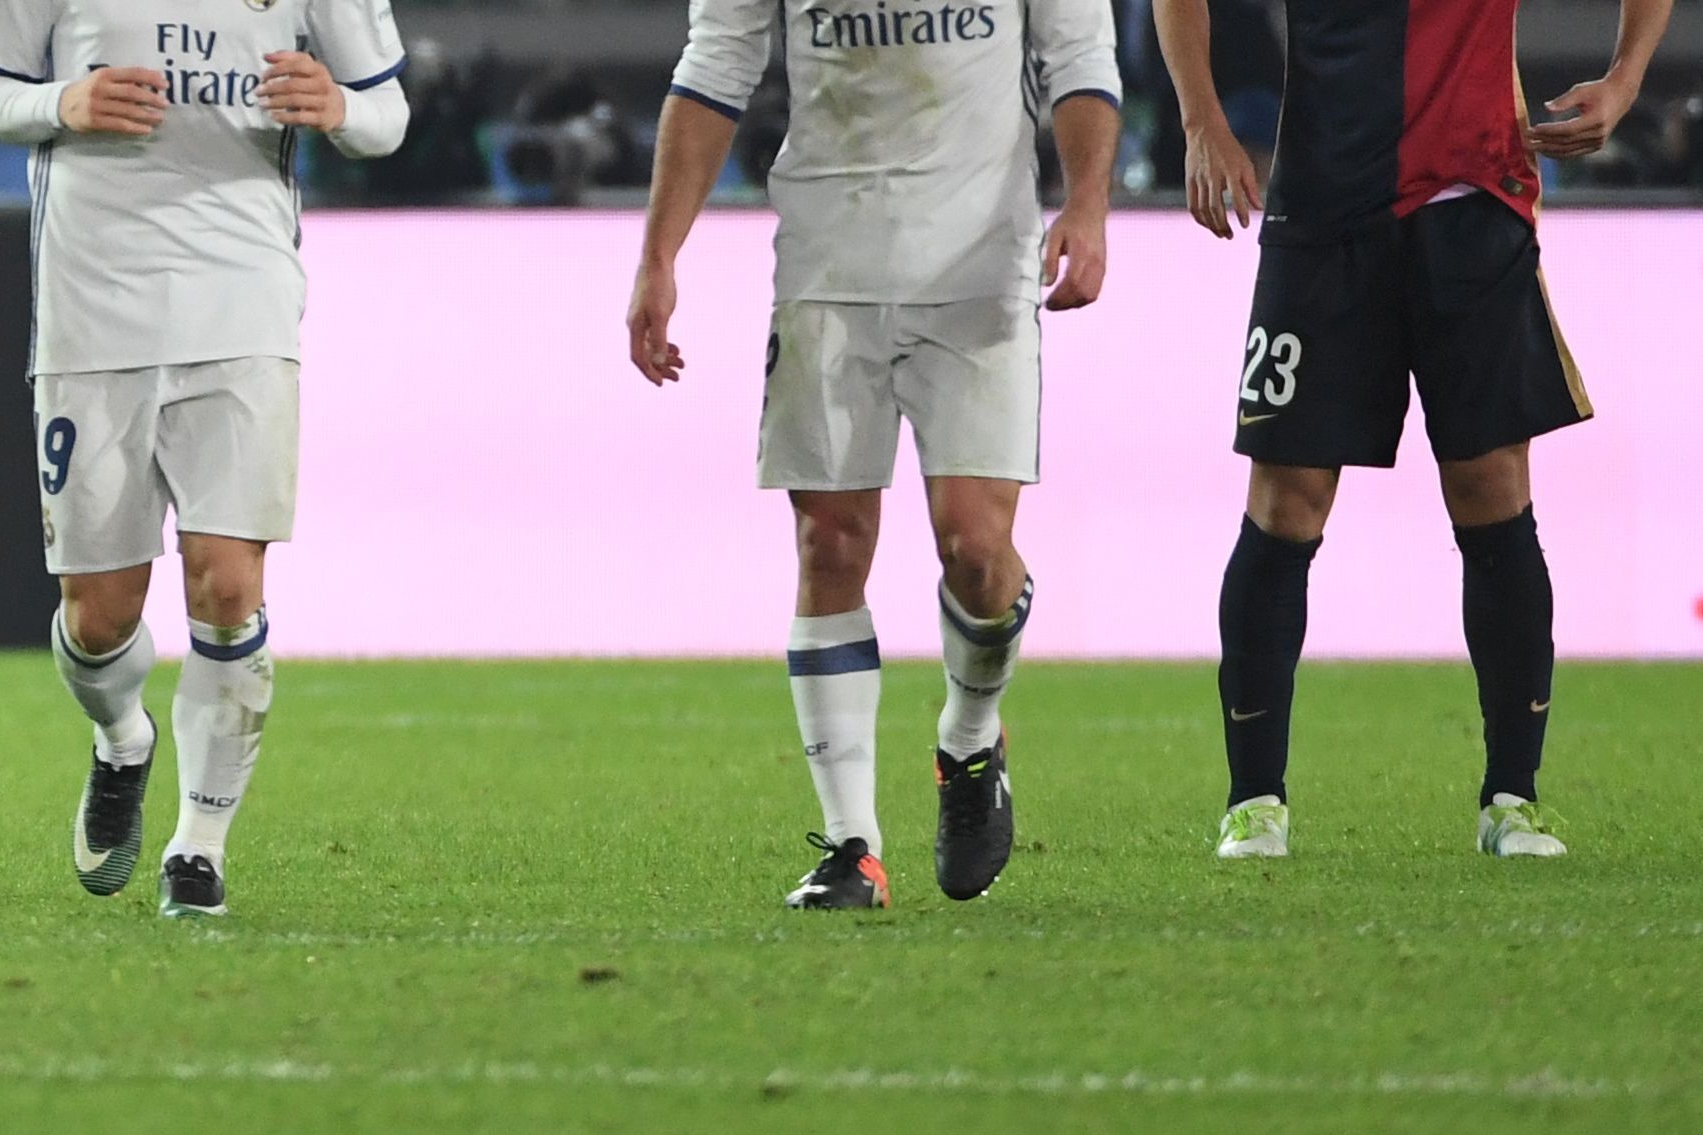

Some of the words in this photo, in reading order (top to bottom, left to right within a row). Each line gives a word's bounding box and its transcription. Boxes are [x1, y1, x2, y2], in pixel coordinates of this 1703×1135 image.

[156, 22, 217, 61] Fly
[804, 2, 996, 49] Emirates
[1240, 325, 1303, 406] 23
